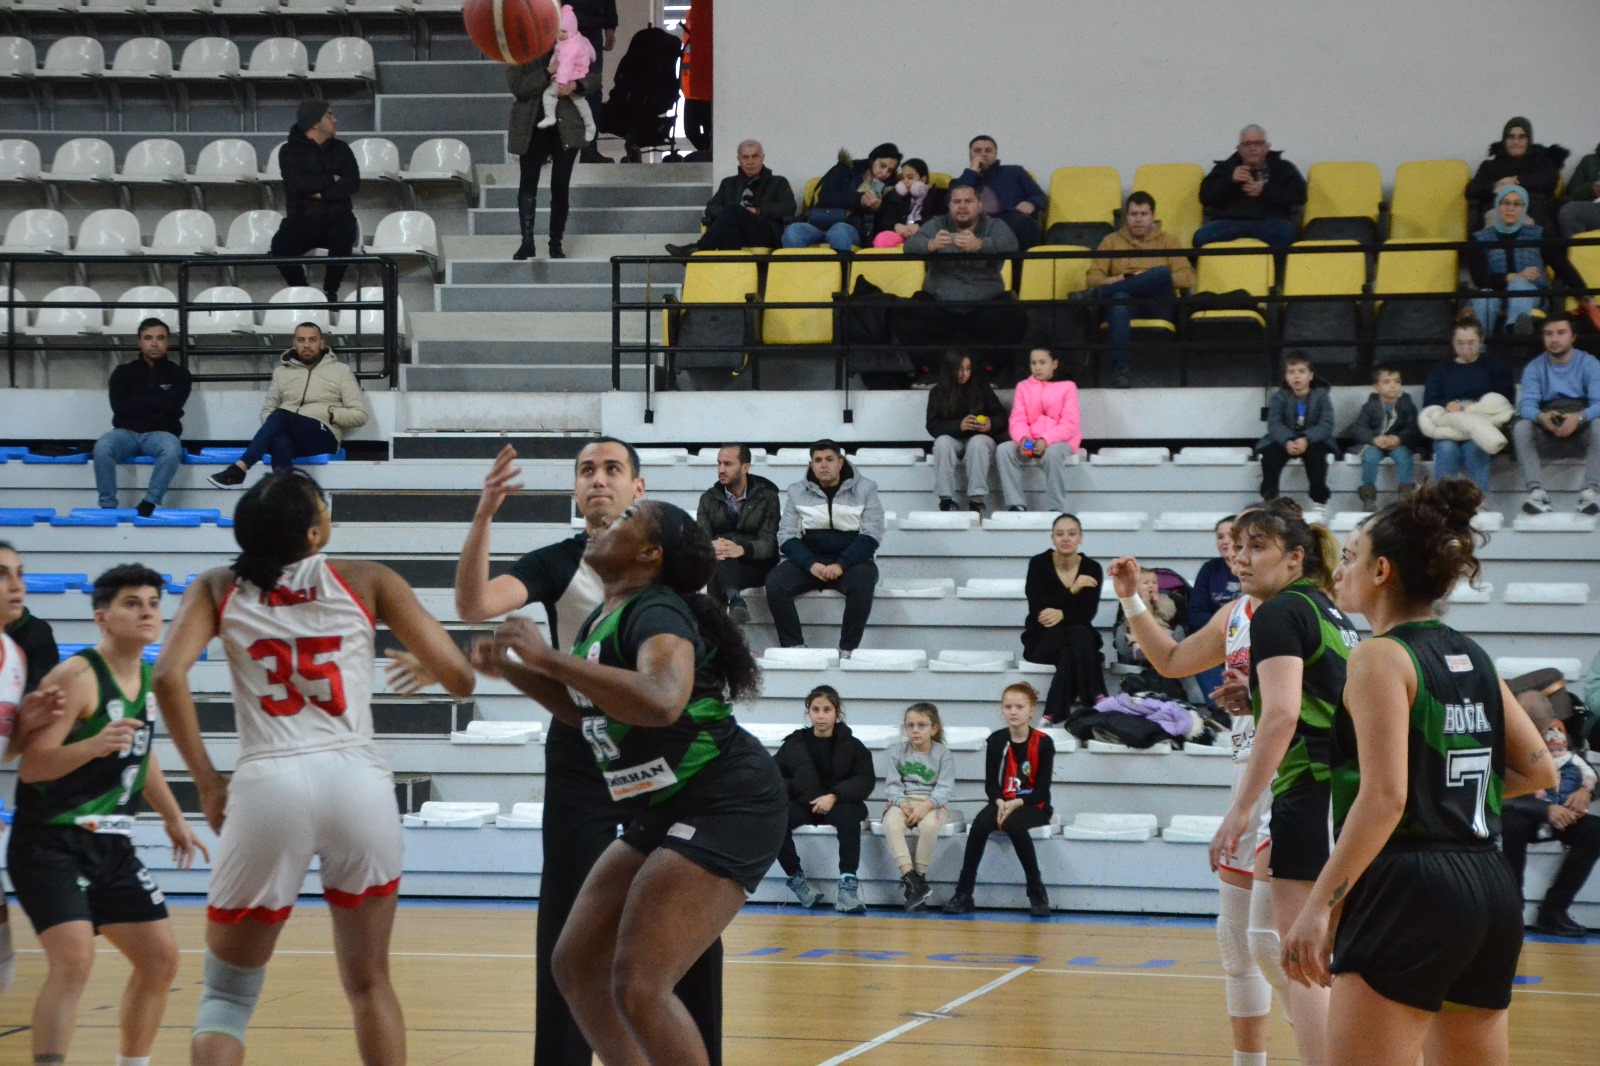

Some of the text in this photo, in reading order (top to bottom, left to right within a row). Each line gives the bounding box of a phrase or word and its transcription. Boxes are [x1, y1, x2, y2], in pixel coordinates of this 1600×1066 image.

[247, 636, 347, 717] 35
[582, 716, 621, 762] 55
[1446, 747, 1493, 839] 7
